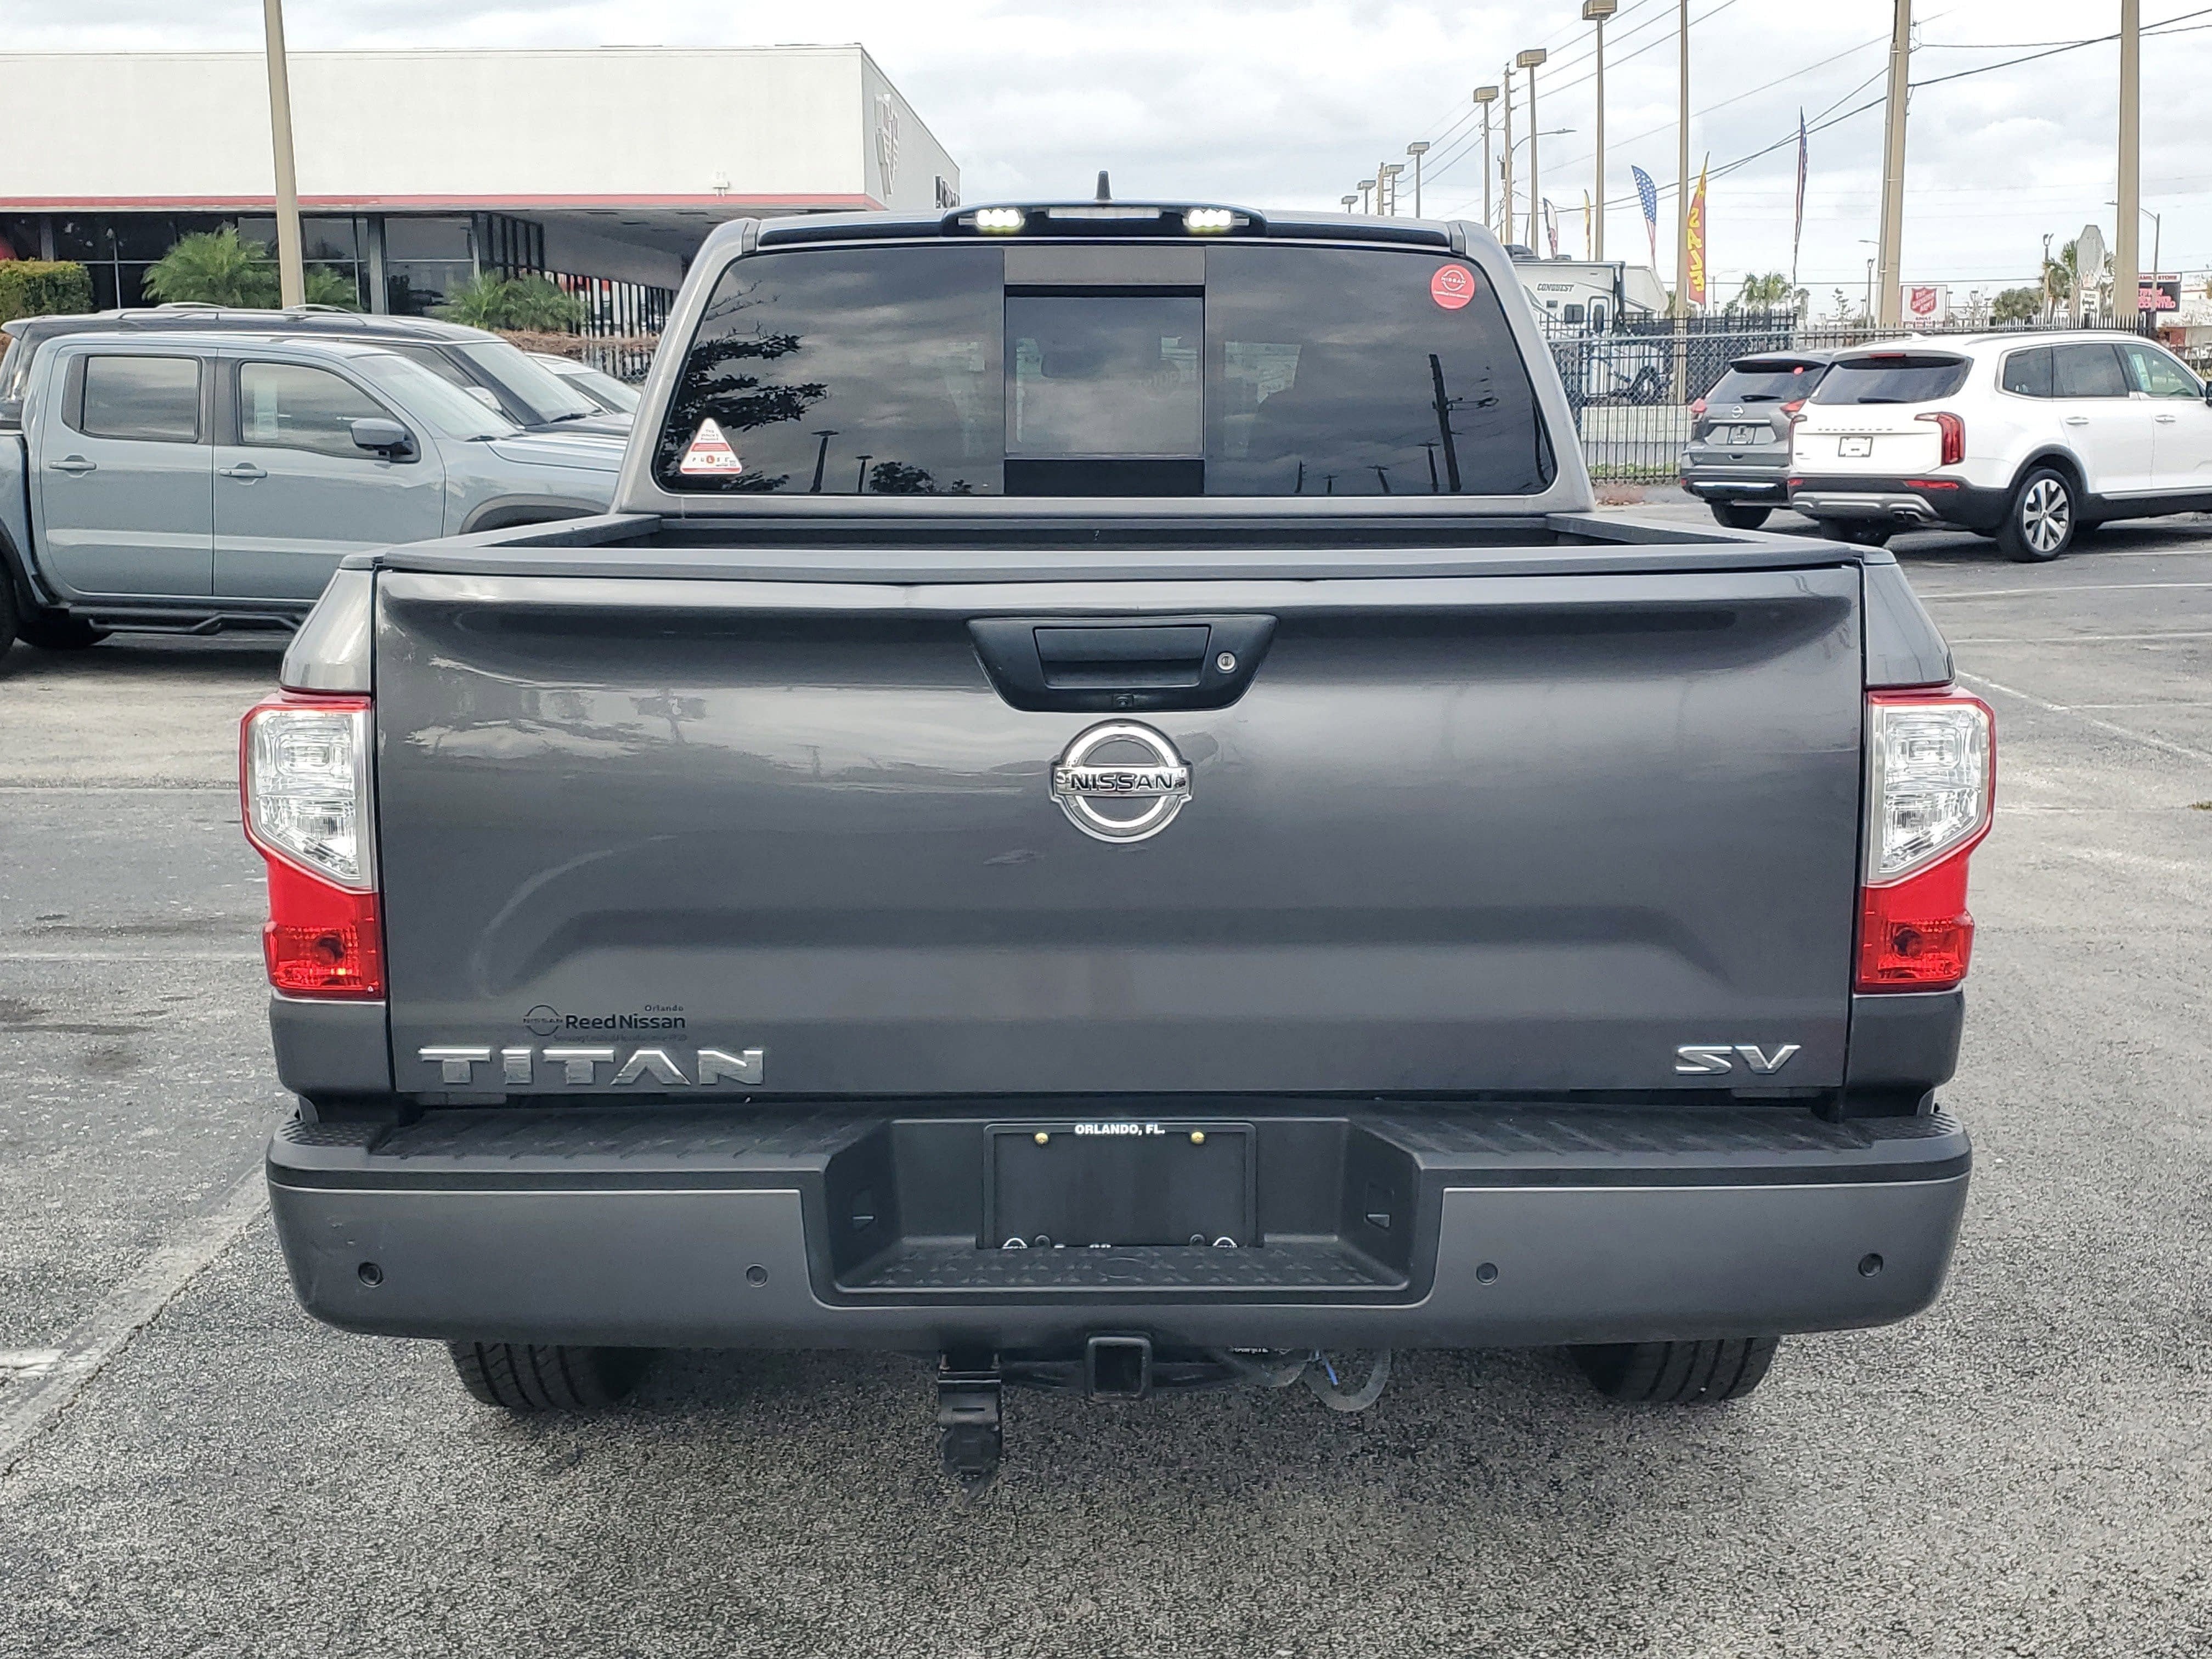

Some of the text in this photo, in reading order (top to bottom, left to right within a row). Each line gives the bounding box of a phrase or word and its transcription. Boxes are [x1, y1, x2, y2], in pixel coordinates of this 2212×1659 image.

[1070, 772, 1172, 791] NISSAN
[566, 1013, 686, 1029] Reed Nissan
[417, 1048, 764, 1085] TITAN
[1675, 1044, 1802, 1075] SV
[1074, 1124, 1166, 1136] ORLANDO, FL.
